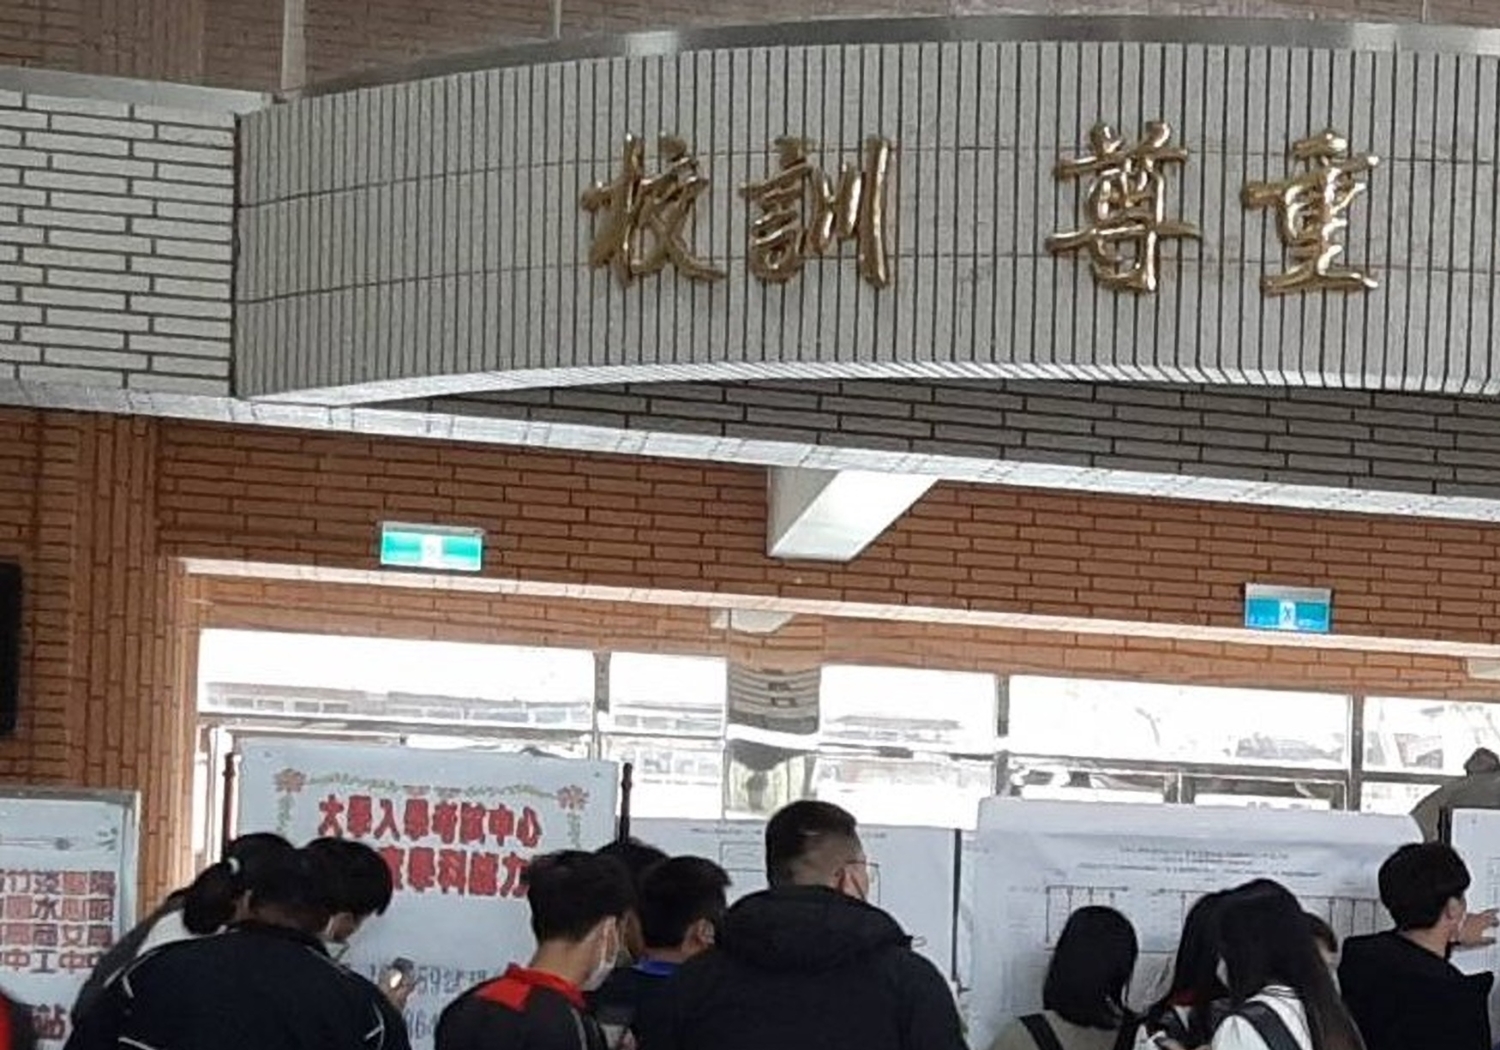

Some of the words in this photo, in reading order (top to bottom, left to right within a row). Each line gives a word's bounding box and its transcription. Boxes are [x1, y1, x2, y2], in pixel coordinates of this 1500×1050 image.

[582, 131, 897, 289] 校訓
[1043, 121, 1380, 296] 尊重
[318, 794, 543, 848] 大學入學考試中心
